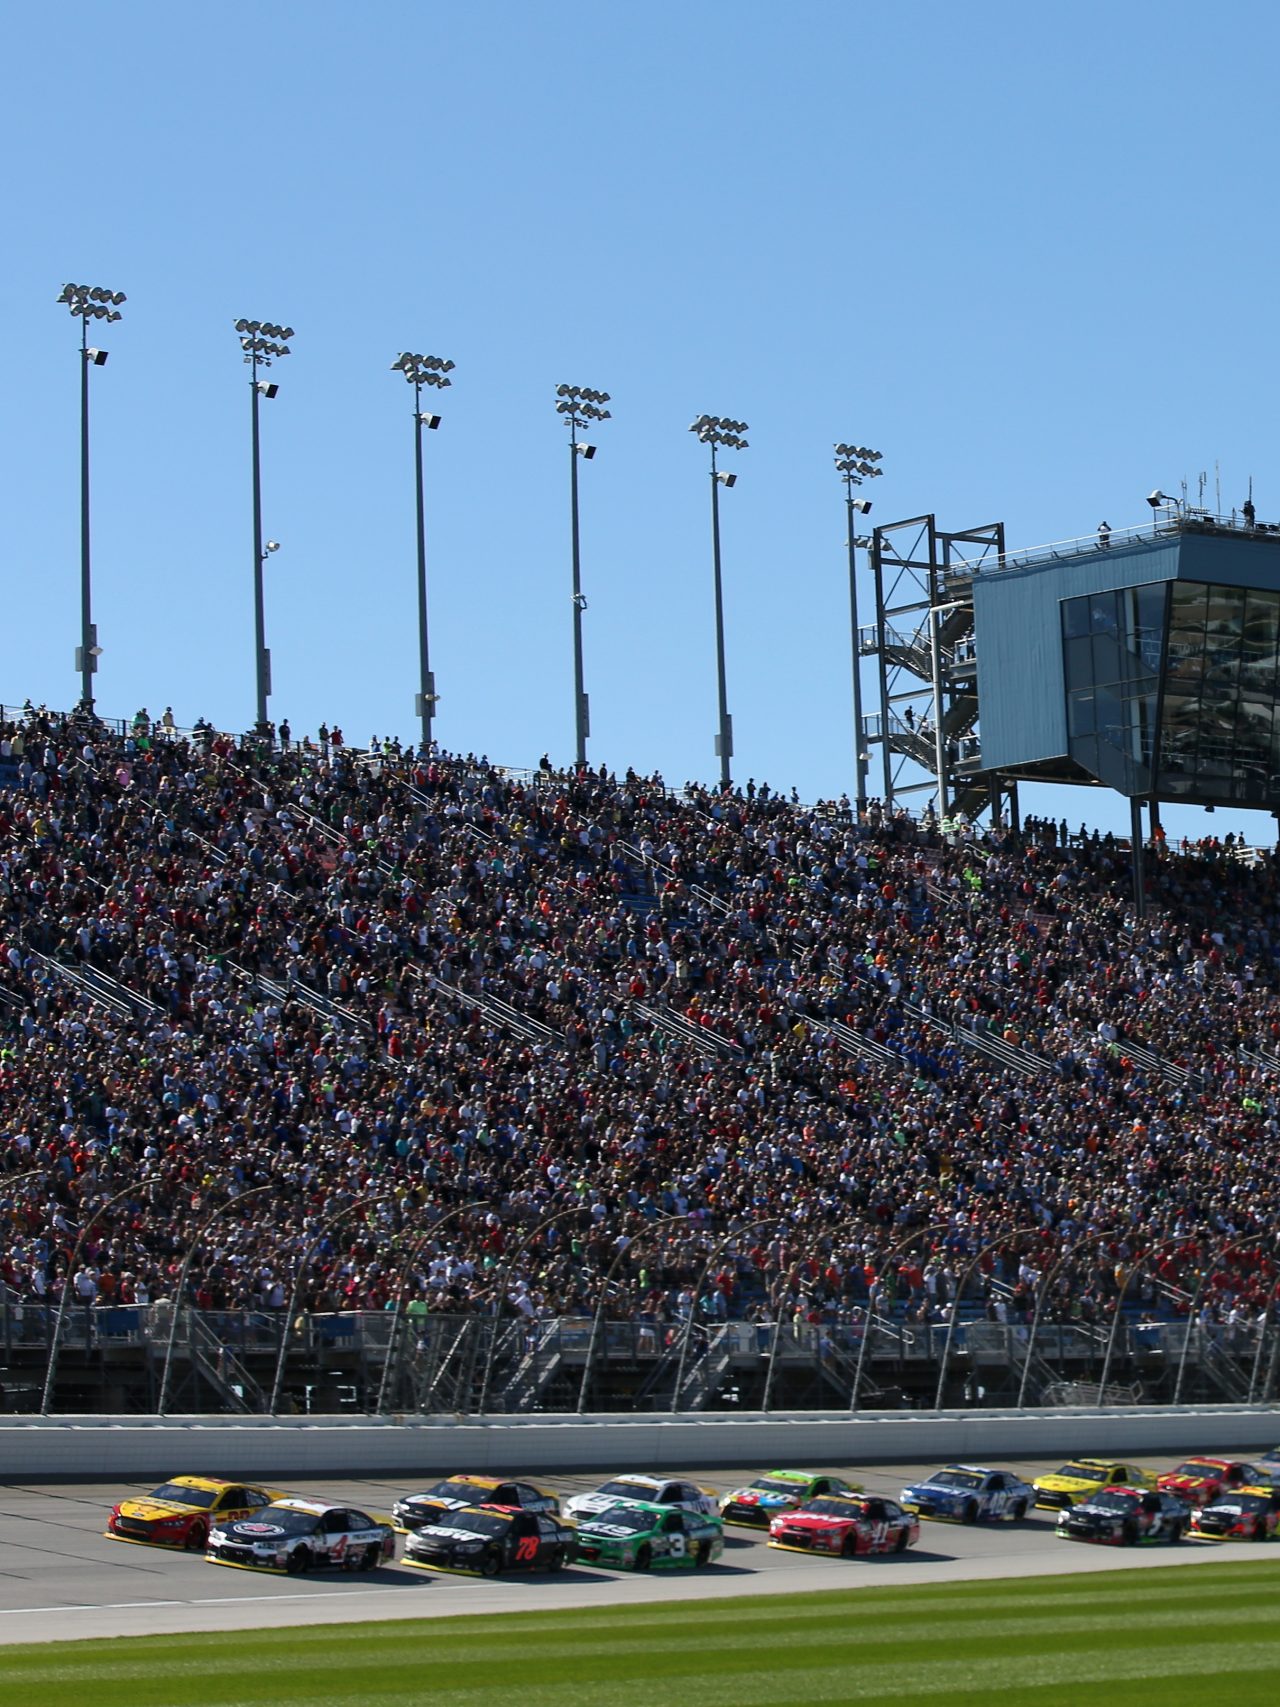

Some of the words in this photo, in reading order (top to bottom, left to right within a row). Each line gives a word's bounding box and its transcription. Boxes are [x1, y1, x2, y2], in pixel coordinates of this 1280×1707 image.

[405, 1493, 472, 1511] CAT
[668, 1532, 686, 1558] 3
[871, 1521, 890, 1545] 41
[329, 1534, 349, 1563] 4
[515, 1536, 542, 1561] 78
